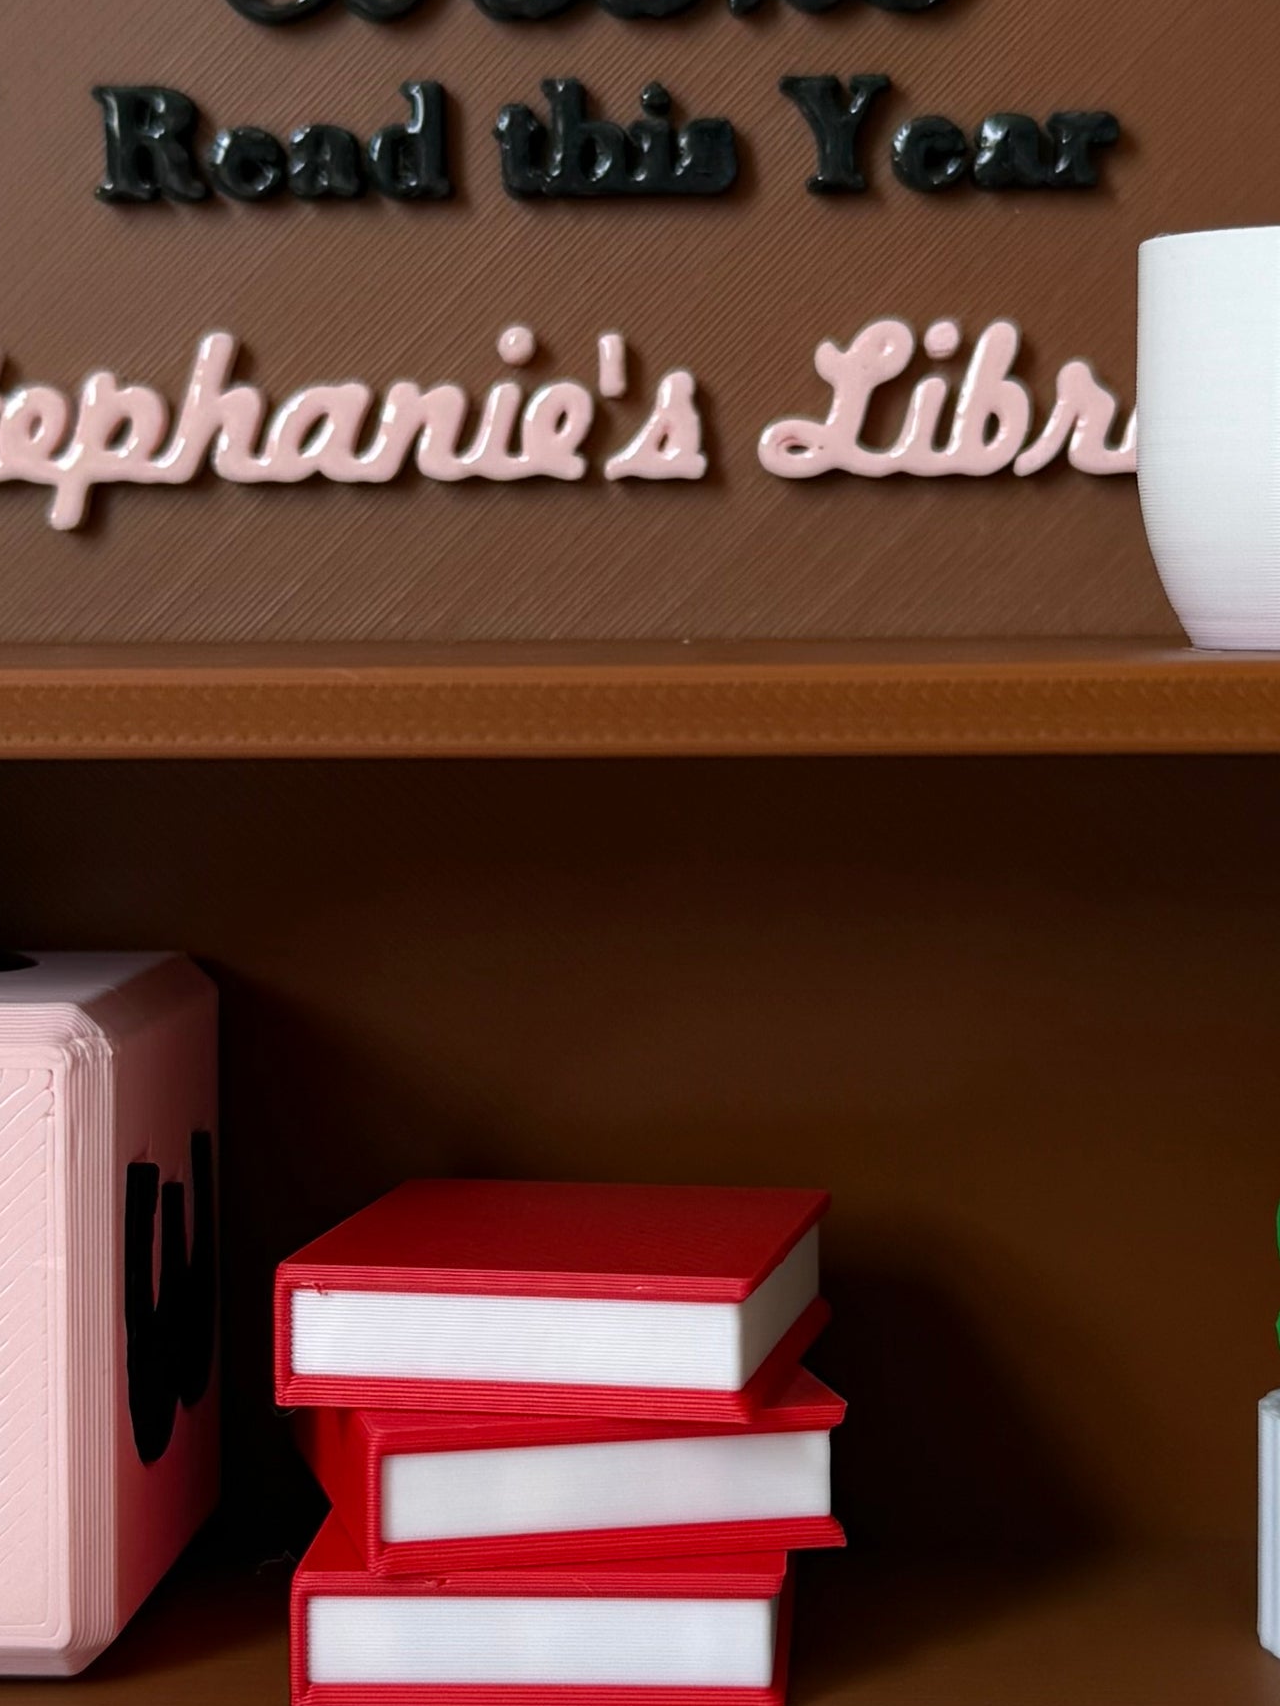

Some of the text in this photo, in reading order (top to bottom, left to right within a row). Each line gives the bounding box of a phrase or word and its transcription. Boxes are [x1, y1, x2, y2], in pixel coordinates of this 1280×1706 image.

[92, 73, 1120, 205] Read this Year
[757, 319, 1138, 479] Libr
